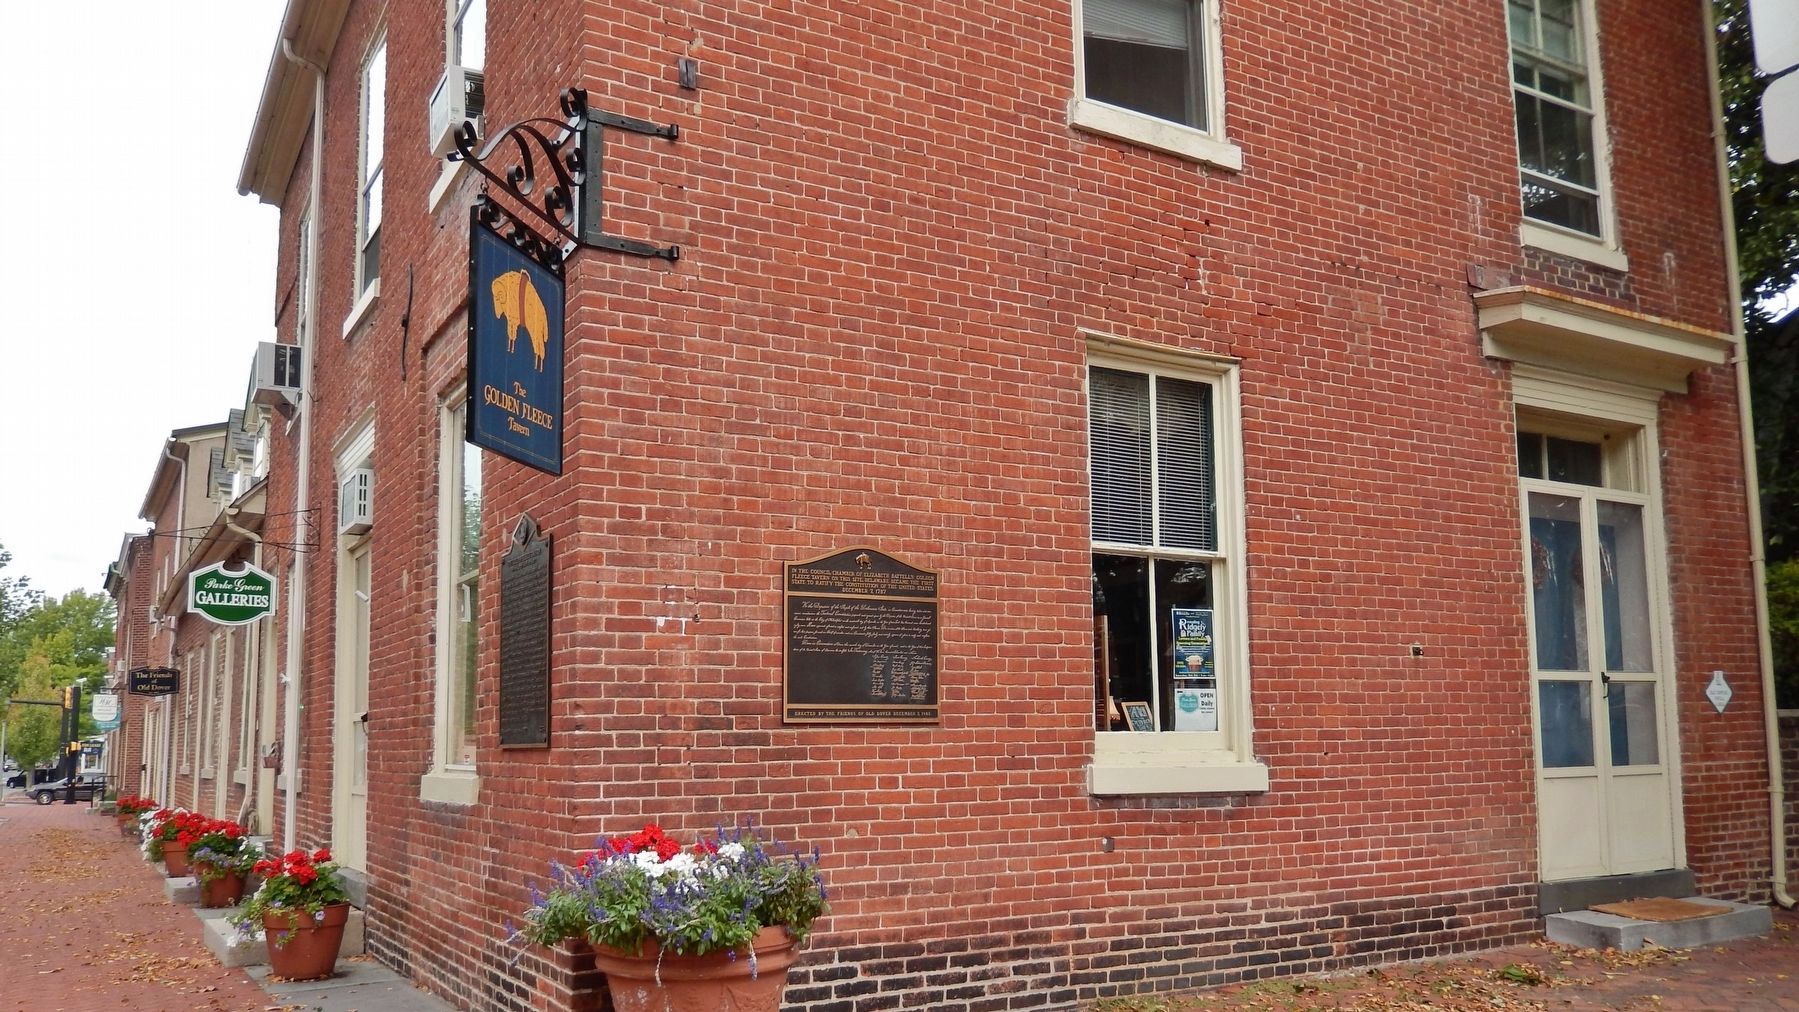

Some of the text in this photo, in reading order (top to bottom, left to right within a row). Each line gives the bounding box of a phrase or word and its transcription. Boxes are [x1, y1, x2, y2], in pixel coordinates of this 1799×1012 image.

[513, 381, 527, 398] The
[484, 384, 553, 430] GOLDEN FLEECE
[508, 416, 530, 437] Tavern
[204, 577, 264, 592] Parke Green
[195, 590, 269, 608] GALLERIES
